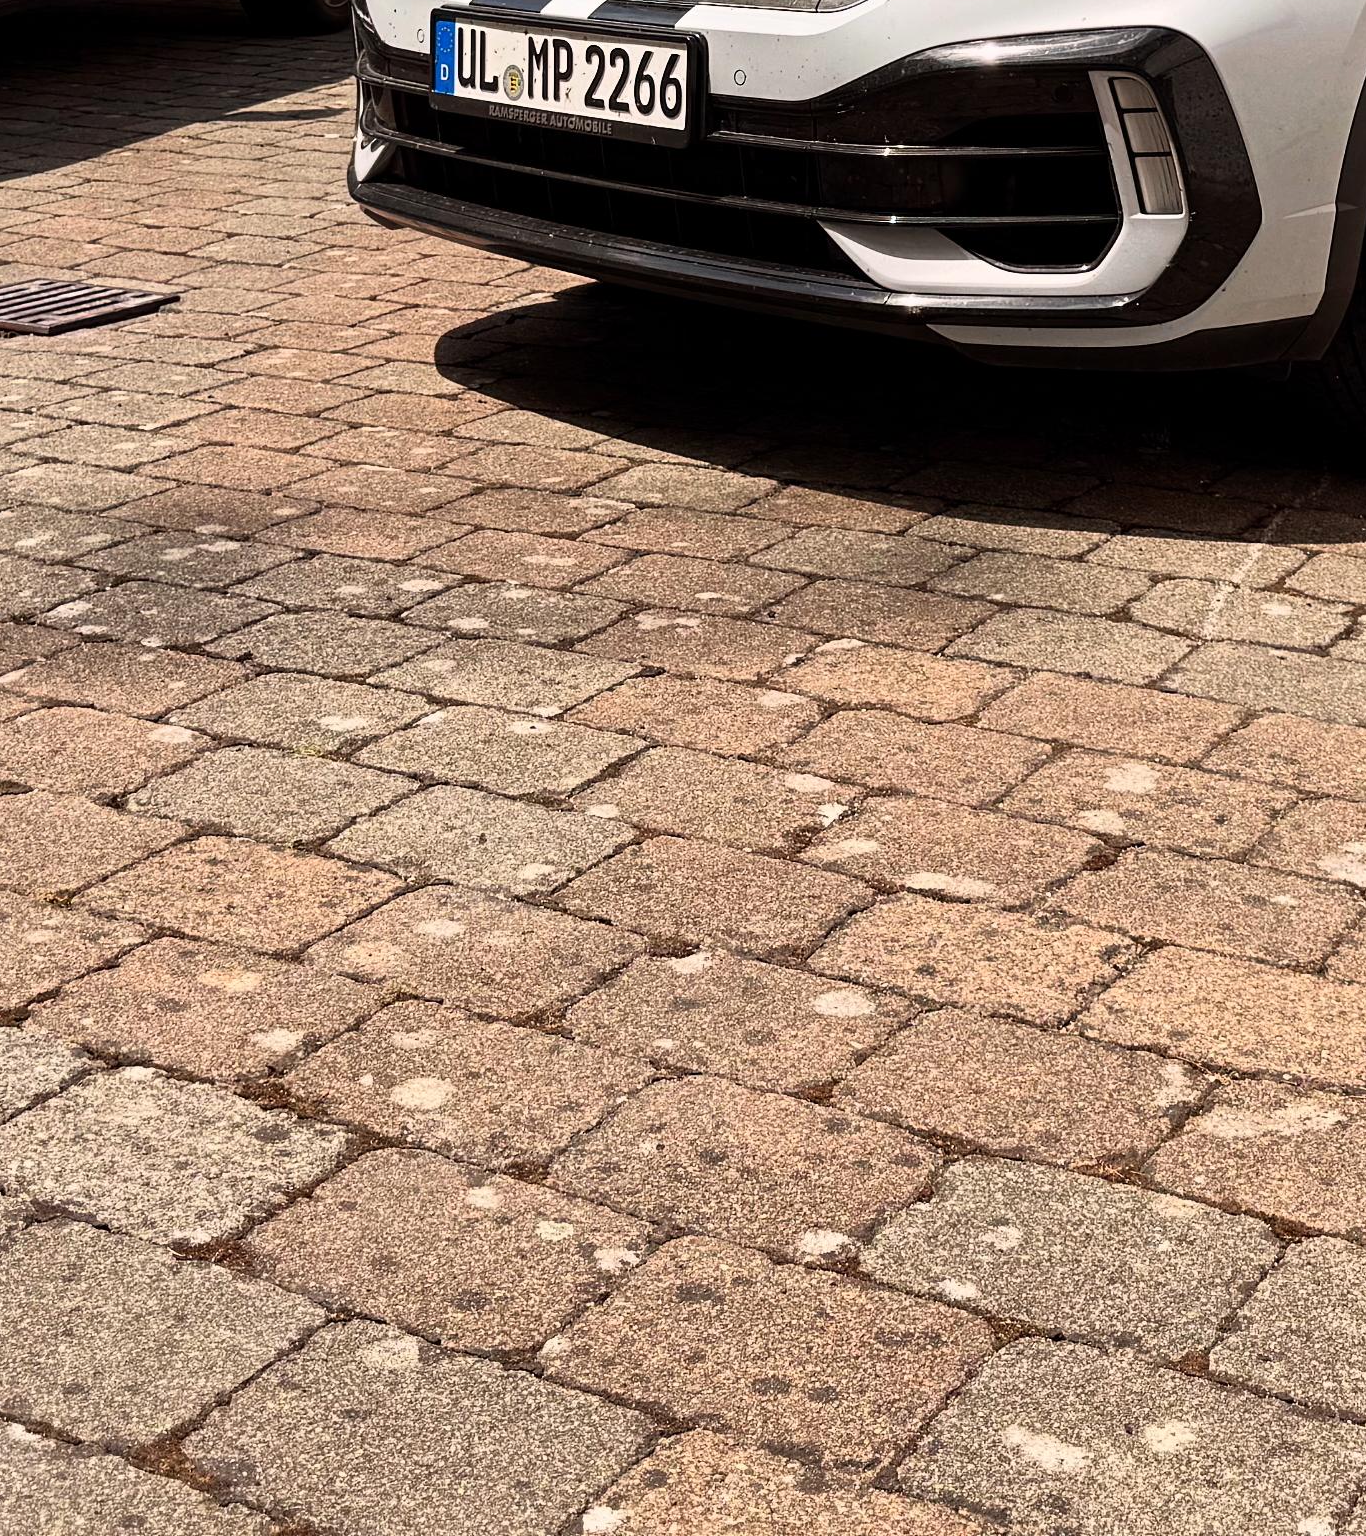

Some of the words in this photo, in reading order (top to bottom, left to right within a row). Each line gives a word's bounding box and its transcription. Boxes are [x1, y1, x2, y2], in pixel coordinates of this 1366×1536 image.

[440, 64, 449, 81] D
[457, 26, 499, 94] UL
[528, 36, 574, 103] MP
[584, 44, 683, 120] 2266
[489, 104, 549, 127] RAMSPERGER
[549, 114, 613, 135] AUTOMOBILE
